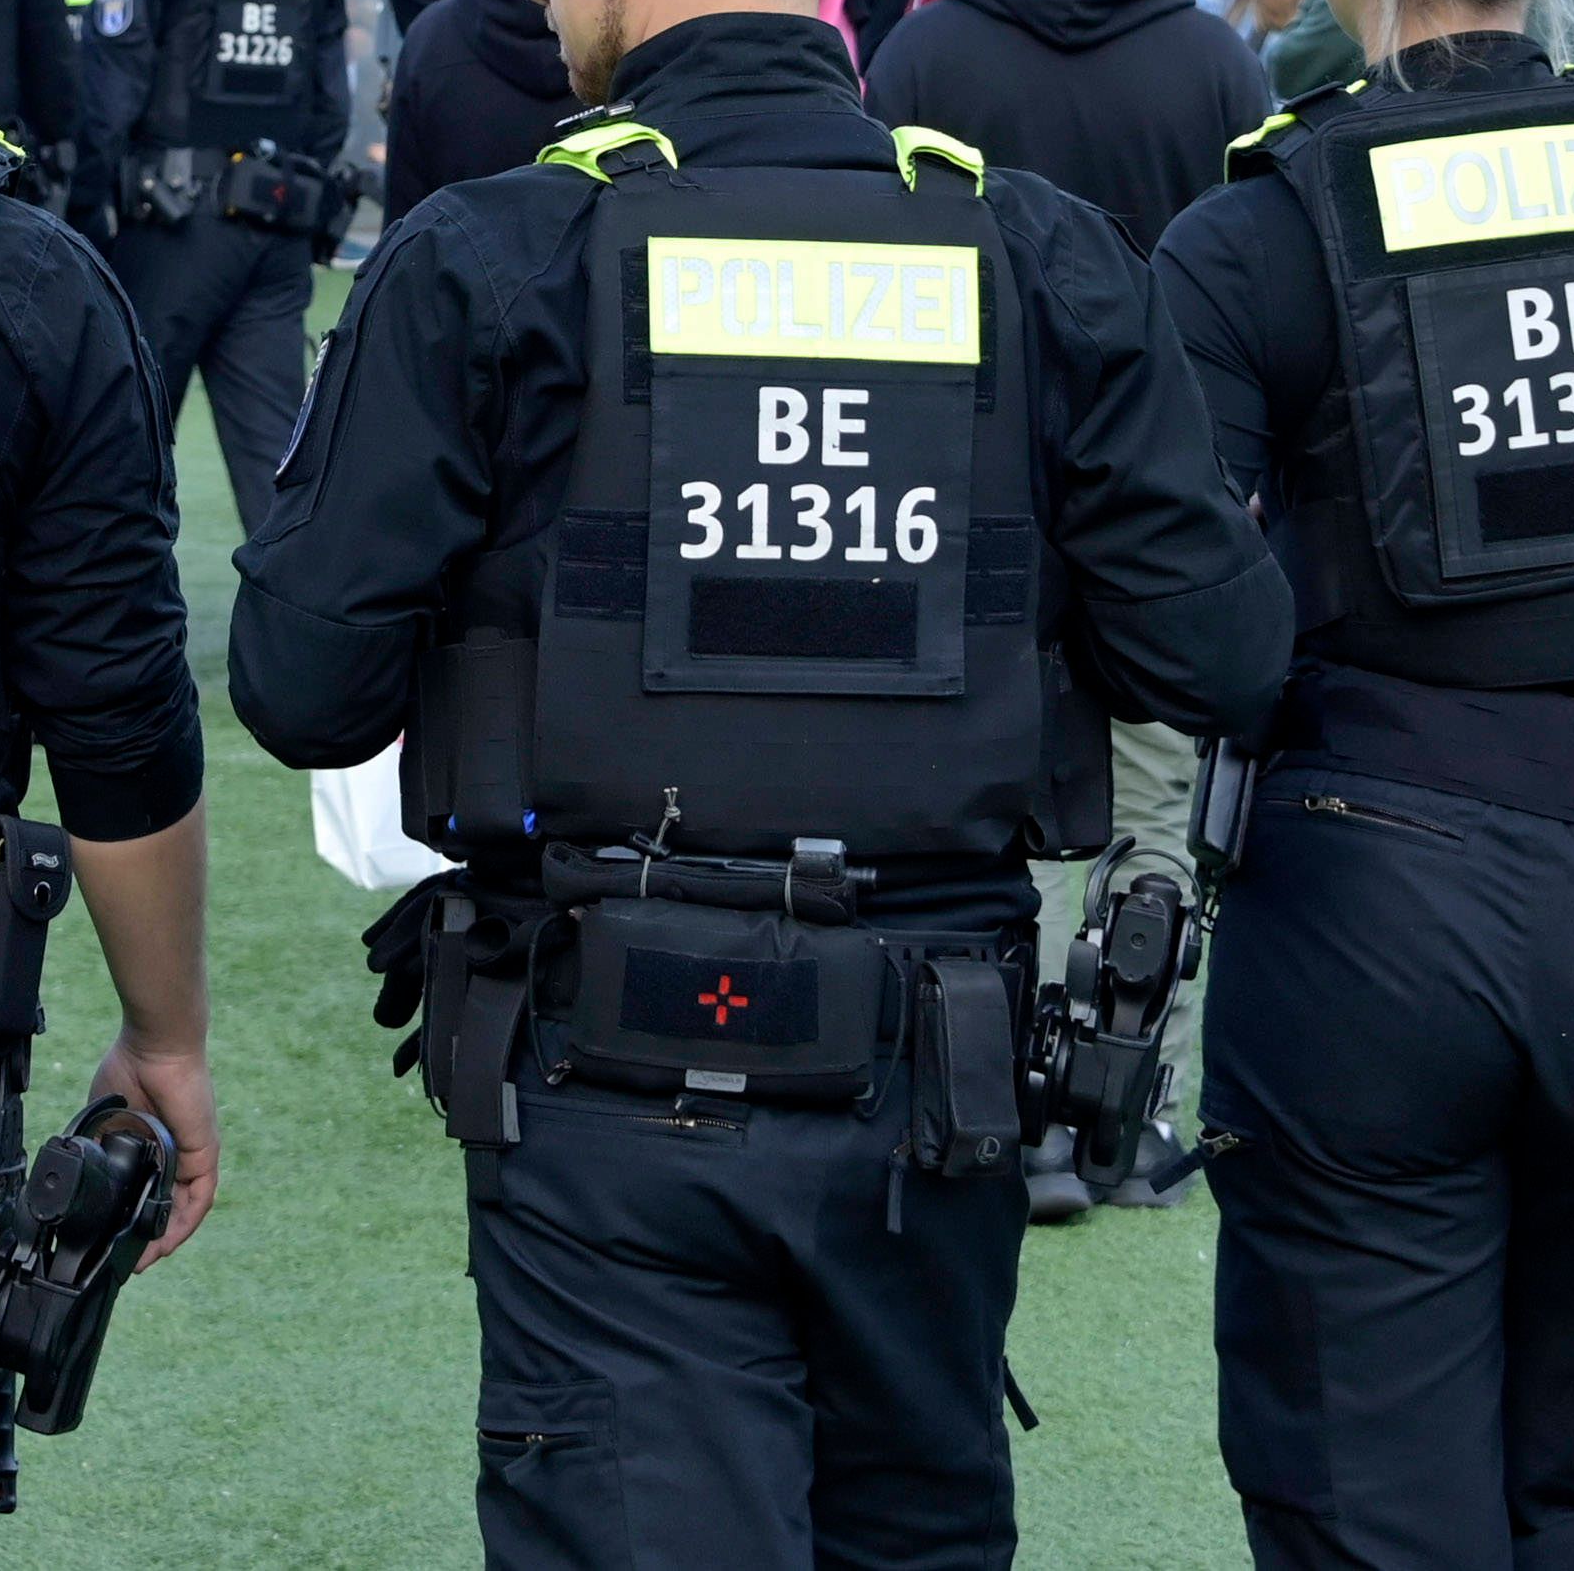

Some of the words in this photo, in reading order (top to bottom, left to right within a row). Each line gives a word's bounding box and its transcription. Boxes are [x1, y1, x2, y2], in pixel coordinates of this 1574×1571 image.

[216, 31, 293, 66] 31226
[241, 1, 277, 35] BE
[661, 256, 966, 344] POLIZEI
[758, 386, 869, 466] BE
[679, 481, 939, 564] 31316
